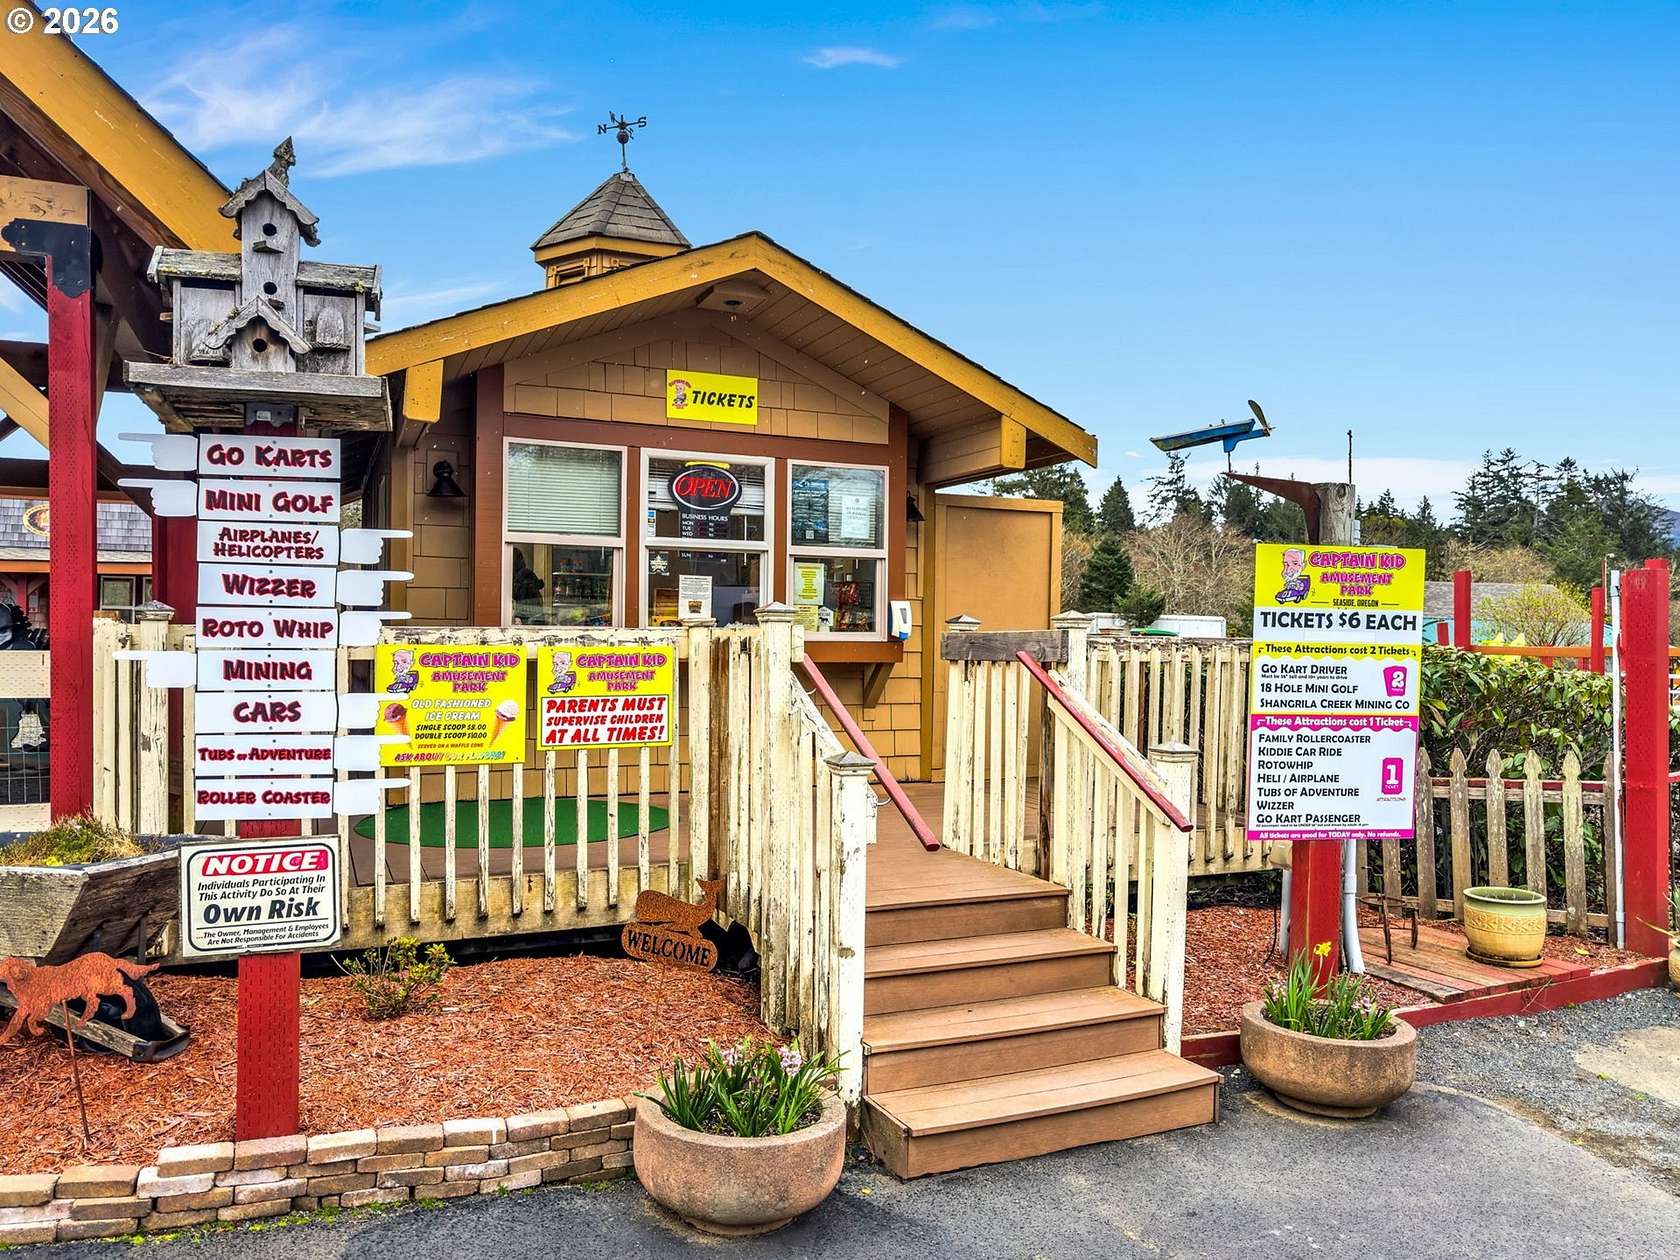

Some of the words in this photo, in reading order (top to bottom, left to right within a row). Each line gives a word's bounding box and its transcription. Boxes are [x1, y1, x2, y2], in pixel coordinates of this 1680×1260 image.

[638, 117, 647, 128] S
[597, 124, 607, 135] N
[692, 390, 755, 409] TICKETS
[206, 443, 245, 467] GO
[254, 445, 333, 468] KARTS
[677, 476, 734, 499] OPEN
[205, 489, 261, 512] MINI
[272, 491, 333, 514] GOLF
[682, 513, 707, 521] BUSINESS
[218, 526, 320, 545] AIRPLANES/
[213, 542, 324, 560] HELICOPTERS
[1308, 551, 1377, 569] CAPTAIN
[1379, 553, 1406, 570] KID
[1320, 572, 1393, 585] AMUSEMENT
[222, 573, 317, 599] WIZZER
[1340, 585, 1374, 596] PARK
[1357, 599, 1379, 608] OREGON
[1260, 611, 1333, 628] TICKETS
[1338, 612, 1361, 629] $6
[1366, 614, 1417, 631] EACH
[202, 618, 264, 638] ROTO
[273, 619, 334, 639] WHIP
[1265, 644, 1292, 653] These
[1294, 645, 1347, 655] Attractions
[1350, 647, 1368, 655] cost
[1370, 646, 1377, 655] 2
[1378, 646, 1410, 655] Tickets
[419, 652, 491, 668] CAPTAIN
[493, 652, 521, 667] KID
[576, 653, 640, 668] CAPTAIN
[641, 653, 667, 667] KID
[223, 659, 312, 681] MINING
[587, 670, 656, 681] AMUSEMENT
[1261, 664, 1278, 674] GO
[1280, 664, 1308, 675] KART
[1310, 665, 1348, 675] DRIVER
[431, 671, 508, 682] AMUSEMENT
[1391, 671, 1405, 688] 2
[453, 682, 487, 693] PARK
[606, 681, 638, 691] PARK
[1260, 683, 1272, 693] 18
[1274, 683, 1303, 693] HOLE
[1305, 683, 1329, 694] MINI
[1330, 684, 1359, 694] GOLF
[411, 700, 432, 709] OLD
[434, 699, 491, 709] FASHIONED
[546, 698, 618, 713] PARENTS
[621, 697, 667, 712] MUST
[1260, 698, 1317, 709] SHANGRILA
[1320, 699, 1353, 709] CREEK
[1355, 699, 1392, 710] MINING
[1394, 699, 1410, 710] CO
[233, 700, 302, 723] CARS
[425, 711, 443, 721] ICE
[445, 711, 481, 721] CREAM
[546, 715, 608, 727] SUPERVISE
[610, 713, 664, 725] CHILDREN
[1265, 716, 1292, 726] These
[1294, 716, 1347, 727] Attractions
[1349, 718, 1367, 727] cost
[1369, 718, 1374, 726] 1
[1375, 717, 1404, 727] Ticket
[416, 723, 442, 731] SINGLE
[442, 723, 466, 731] SCOOP
[415, 732, 442, 740] DOUBLE
[545, 729, 568, 744] AT
[570, 727, 600, 743] ALL
[607, 725, 665, 742] TIMES!
[1258, 733, 1294, 743] FAMILY
[1296, 734, 1371, 744] ROLLERCOASTER
[198, 748, 235, 761] TUBS
[249, 748, 332, 761] ADVENTURE
[394, 753, 412, 763] ASK
[413, 752, 444, 761] ABOUT
[1258, 747, 1293, 757] KIDDIE
[1295, 747, 1317, 757] CAR
[1319, 747, 1342, 757] RIDE
[1258, 760, 1314, 770] ROTOWHIP
[1257, 773, 1281, 783] HELI
[1289, 773, 1340, 783] AIRPLANE
[1386, 764, 1399, 785] 1
[197, 790, 257, 805] ROLLER
[261, 790, 331, 804] COASTER
[1257, 787, 1282, 797] TUBS
[1284, 787, 1298, 797] OF
[1300, 787, 1360, 797] ADVENTURE
[1257, 800, 1295, 810] WIZZER
[1256, 814, 1273, 823] GO
[1276, 814, 1303, 823] KART
[1305, 813, 1361, 823] PASSENGER
[205, 851, 320, 875] NOTICE
[197, 879, 250, 892] Individuals
[251, 875, 316, 889] Participating
[316, 874, 326, 883] In
[198, 891, 218, 901] This
[219, 888, 258, 901] Activity
[259, 888, 273, 897] Do
[274, 887, 287, 896] So
[288, 886, 300, 895] At
[301, 884, 326, 894] Their
[203, 903, 261, 924] Own
[268, 896, 321, 920] Risk
[217, 929, 242, 938] Owner,
[243, 926, 287, 937] Management
[294, 923, 329, 933] Employees
[207, 938, 220, 946] Are
[220, 937, 233, 945] Not
[234, 934, 274, 945] Responsible
[287, 931, 319, 940] Accidents
[627, 929, 711, 967] WELCOME
